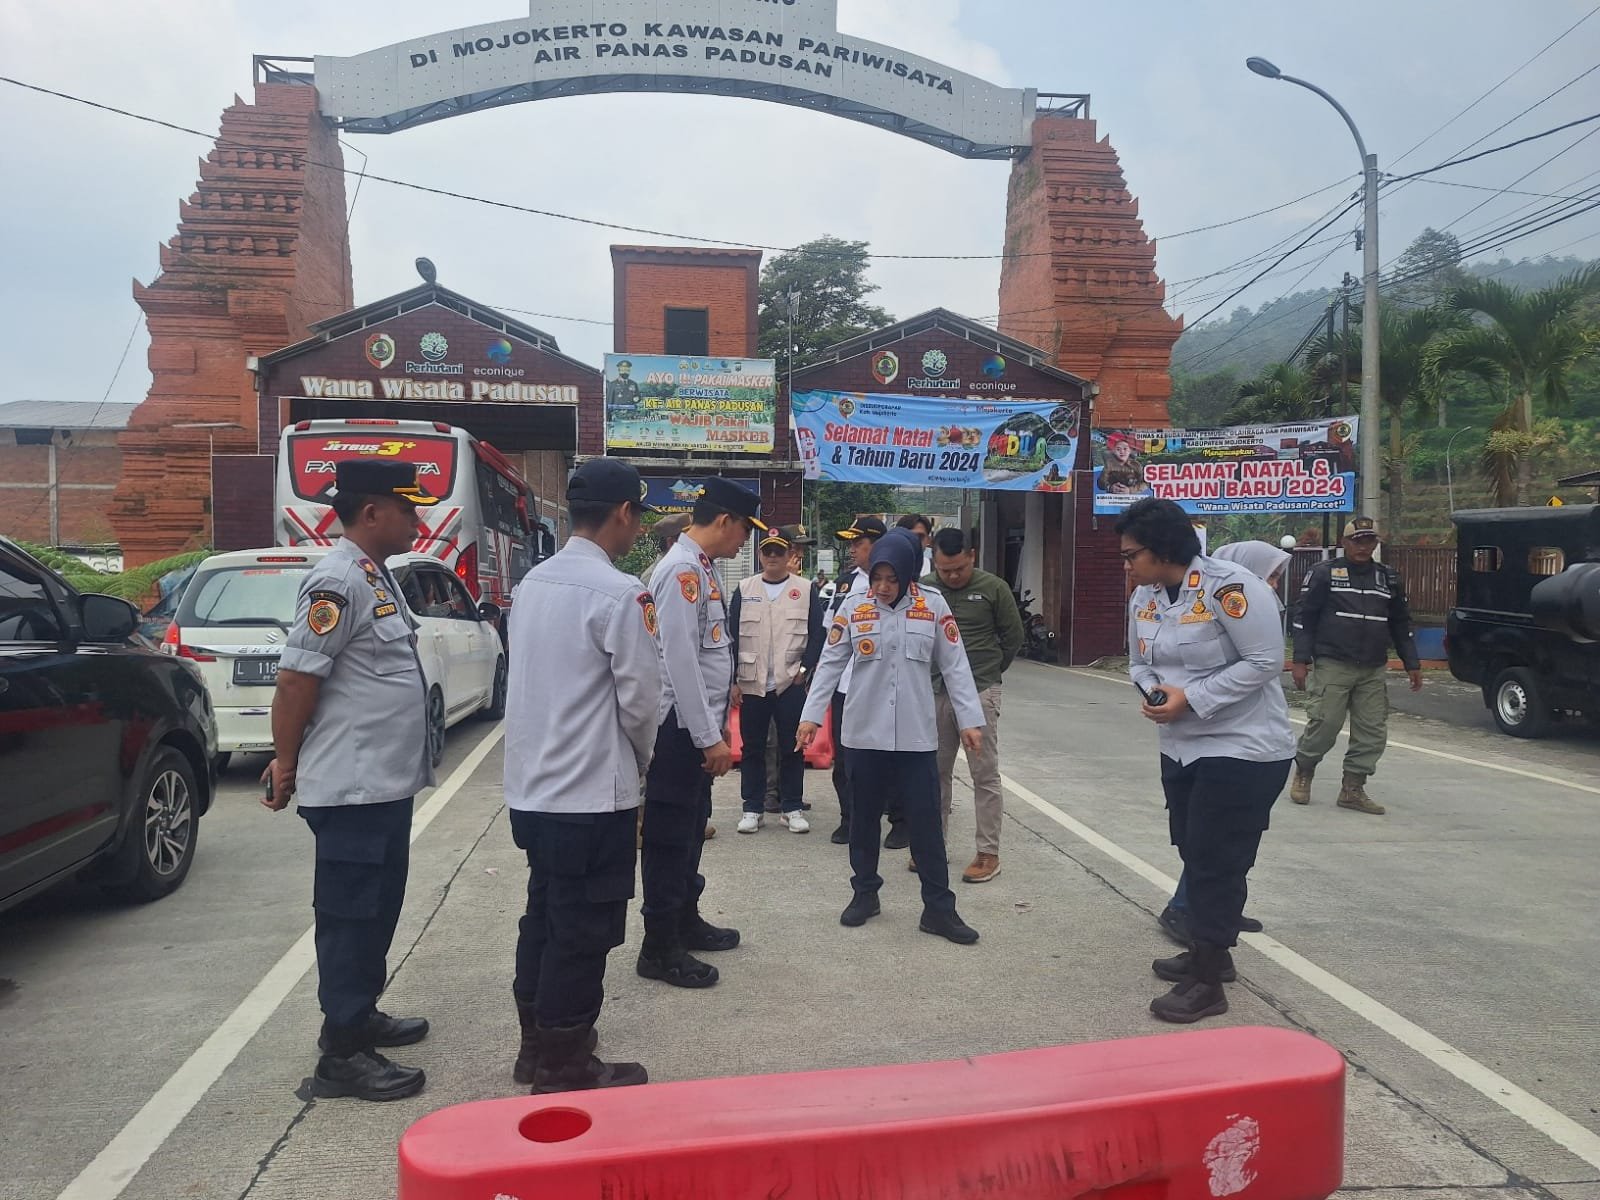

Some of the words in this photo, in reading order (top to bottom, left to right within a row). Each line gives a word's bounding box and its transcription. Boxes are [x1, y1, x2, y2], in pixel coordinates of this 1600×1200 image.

[410, 49, 438, 68] DI
[452, 23, 627, 58] MOJOKERTO
[645, 23, 783, 47] KAWASAN
[798, 37, 953, 95] PARIWISATA
[534, 46, 581, 64] AIR
[596, 43, 689, 58] PANAS
[705, 47, 833, 78] PADUSAN
[406, 361, 464, 374] Perhutani
[473, 366, 525, 377] econique
[647, 372, 674, 385] AYO
[907, 377, 961, 389] Perhutani
[300, 376, 374, 398] Wana
[380, 377, 465, 400] Wisata
[471, 380, 579, 403] Padusan
[679, 388, 730, 397] BERWISATA
[969, 381, 1016, 391] econique
[665, 399, 682, 410] AIR
[685, 400, 716, 411] PANAS
[719, 401, 765, 412] PADUSAN
[671, 414, 712, 427] WAJIB
[706, 430, 769, 442] MASKER
[824, 423, 889, 445] Selamat
[892, 427, 934, 447] Natal
[832, 445, 842, 465] &
[849, 446, 895, 468] Tahun
[899, 450, 936, 470] Baru
[939, 452, 980, 472] 2024
[1145, 463, 1237, 481] SELAMAT
[1243, 461, 1307, 478] NATAL
[1314, 460, 1328, 476] &
[1153, 482, 1219, 498] TAHUN
[1226, 480, 1281, 497] BARU
[1288, 478, 1342, 495] 2024
[1231, 502, 1264, 510] Wisata
[1266, 501, 1308, 510] Padusan
[237, 662, 244, 675] L
[259, 662, 280, 674] 118
